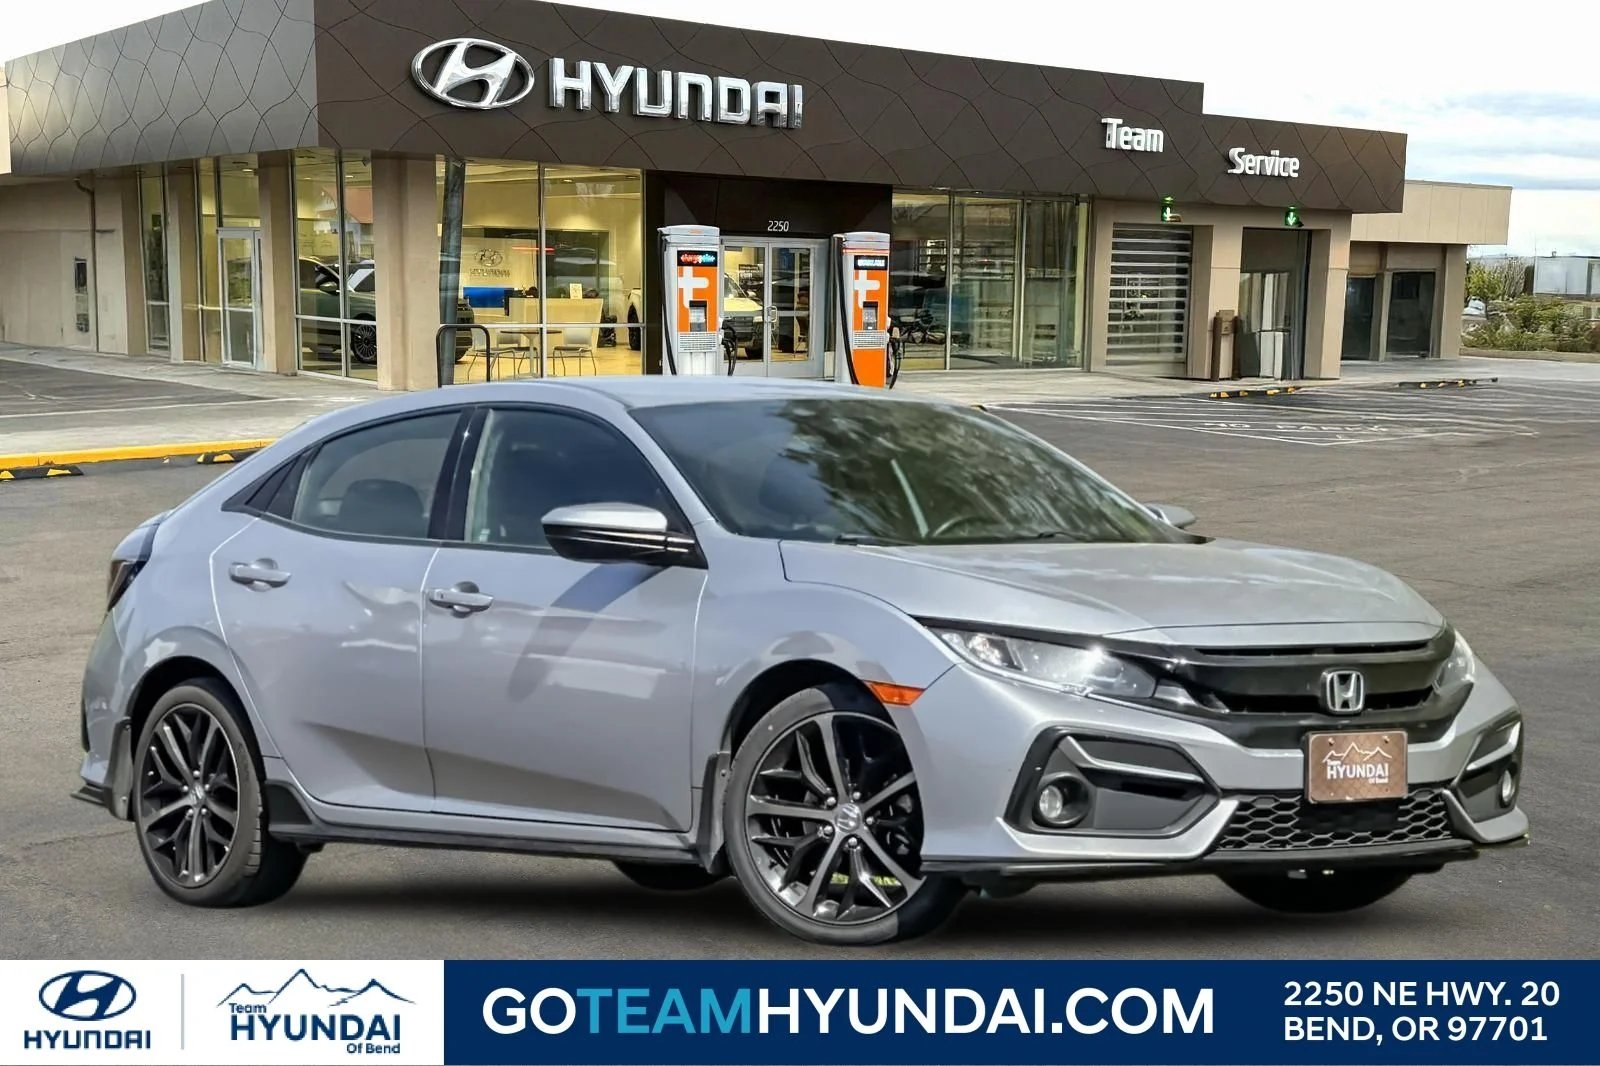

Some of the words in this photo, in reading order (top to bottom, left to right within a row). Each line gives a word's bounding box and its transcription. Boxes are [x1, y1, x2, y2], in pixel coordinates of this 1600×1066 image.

[548, 56, 803, 129] HYUNDAI
[1101, 117, 1164, 152] Team
[1227, 147, 1300, 178] Service
[767, 220, 790, 232] 2250
[1327, 763, 1389, 779] HYUNDAI
